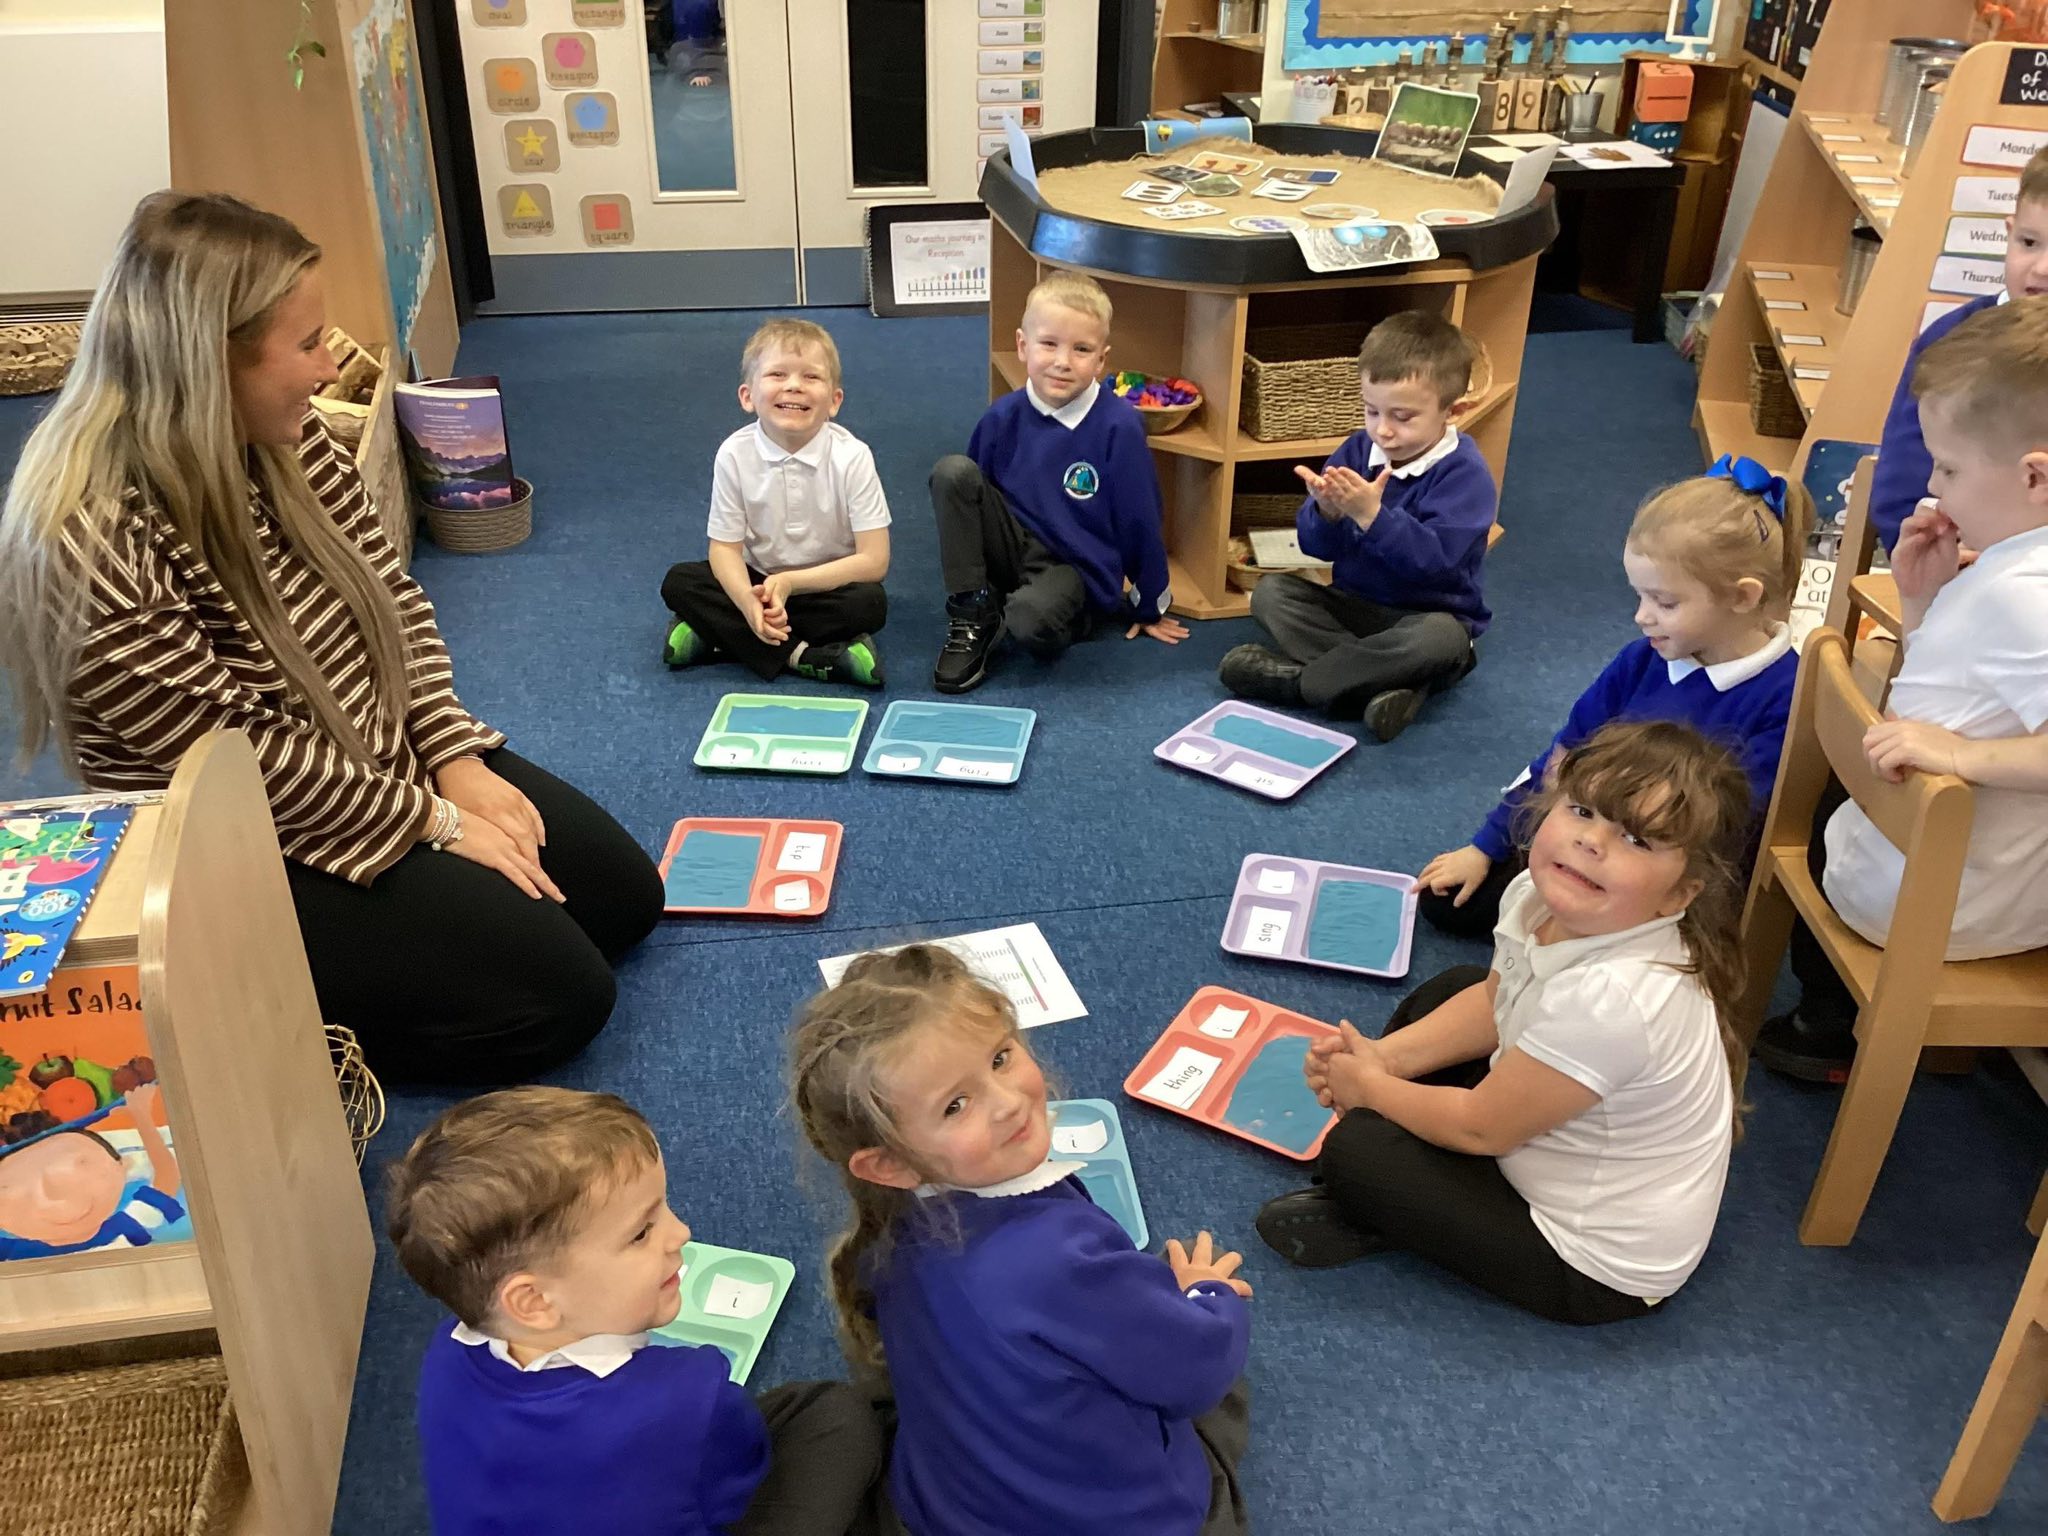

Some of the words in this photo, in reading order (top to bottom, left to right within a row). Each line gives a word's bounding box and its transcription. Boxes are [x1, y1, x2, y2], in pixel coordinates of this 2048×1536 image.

[574, 9, 624, 21] rectangle
[550, 71, 595, 82] hexagon
[2021, 70, 2042, 87] of
[2020, 88, 2048, 101] We
[1496, 92, 1510, 121] 8
[1521, 91, 1538, 119] 9
[570, 131, 617, 142] pentagon
[2000, 142, 2039, 155] Mond
[505, 219, 552, 232] triangle
[590, 231, 630, 244] square
[905, 234, 920, 243] Our
[923, 235, 945, 243] maths
[947, 234, 976, 245] journey
[928, 249, 964, 260] Reception
[1962, 270, 2006, 284] Thursd
[1808, 590, 1828, 603] at
[790, 845, 811, 860] tip
[1258, 923, 1281, 942] sing
[0, 992, 54, 1023] ruit
[67, 980, 142, 1015] Sala
[1163, 1064, 1203, 1090] thing
[732, 1291, 741, 1308] i
